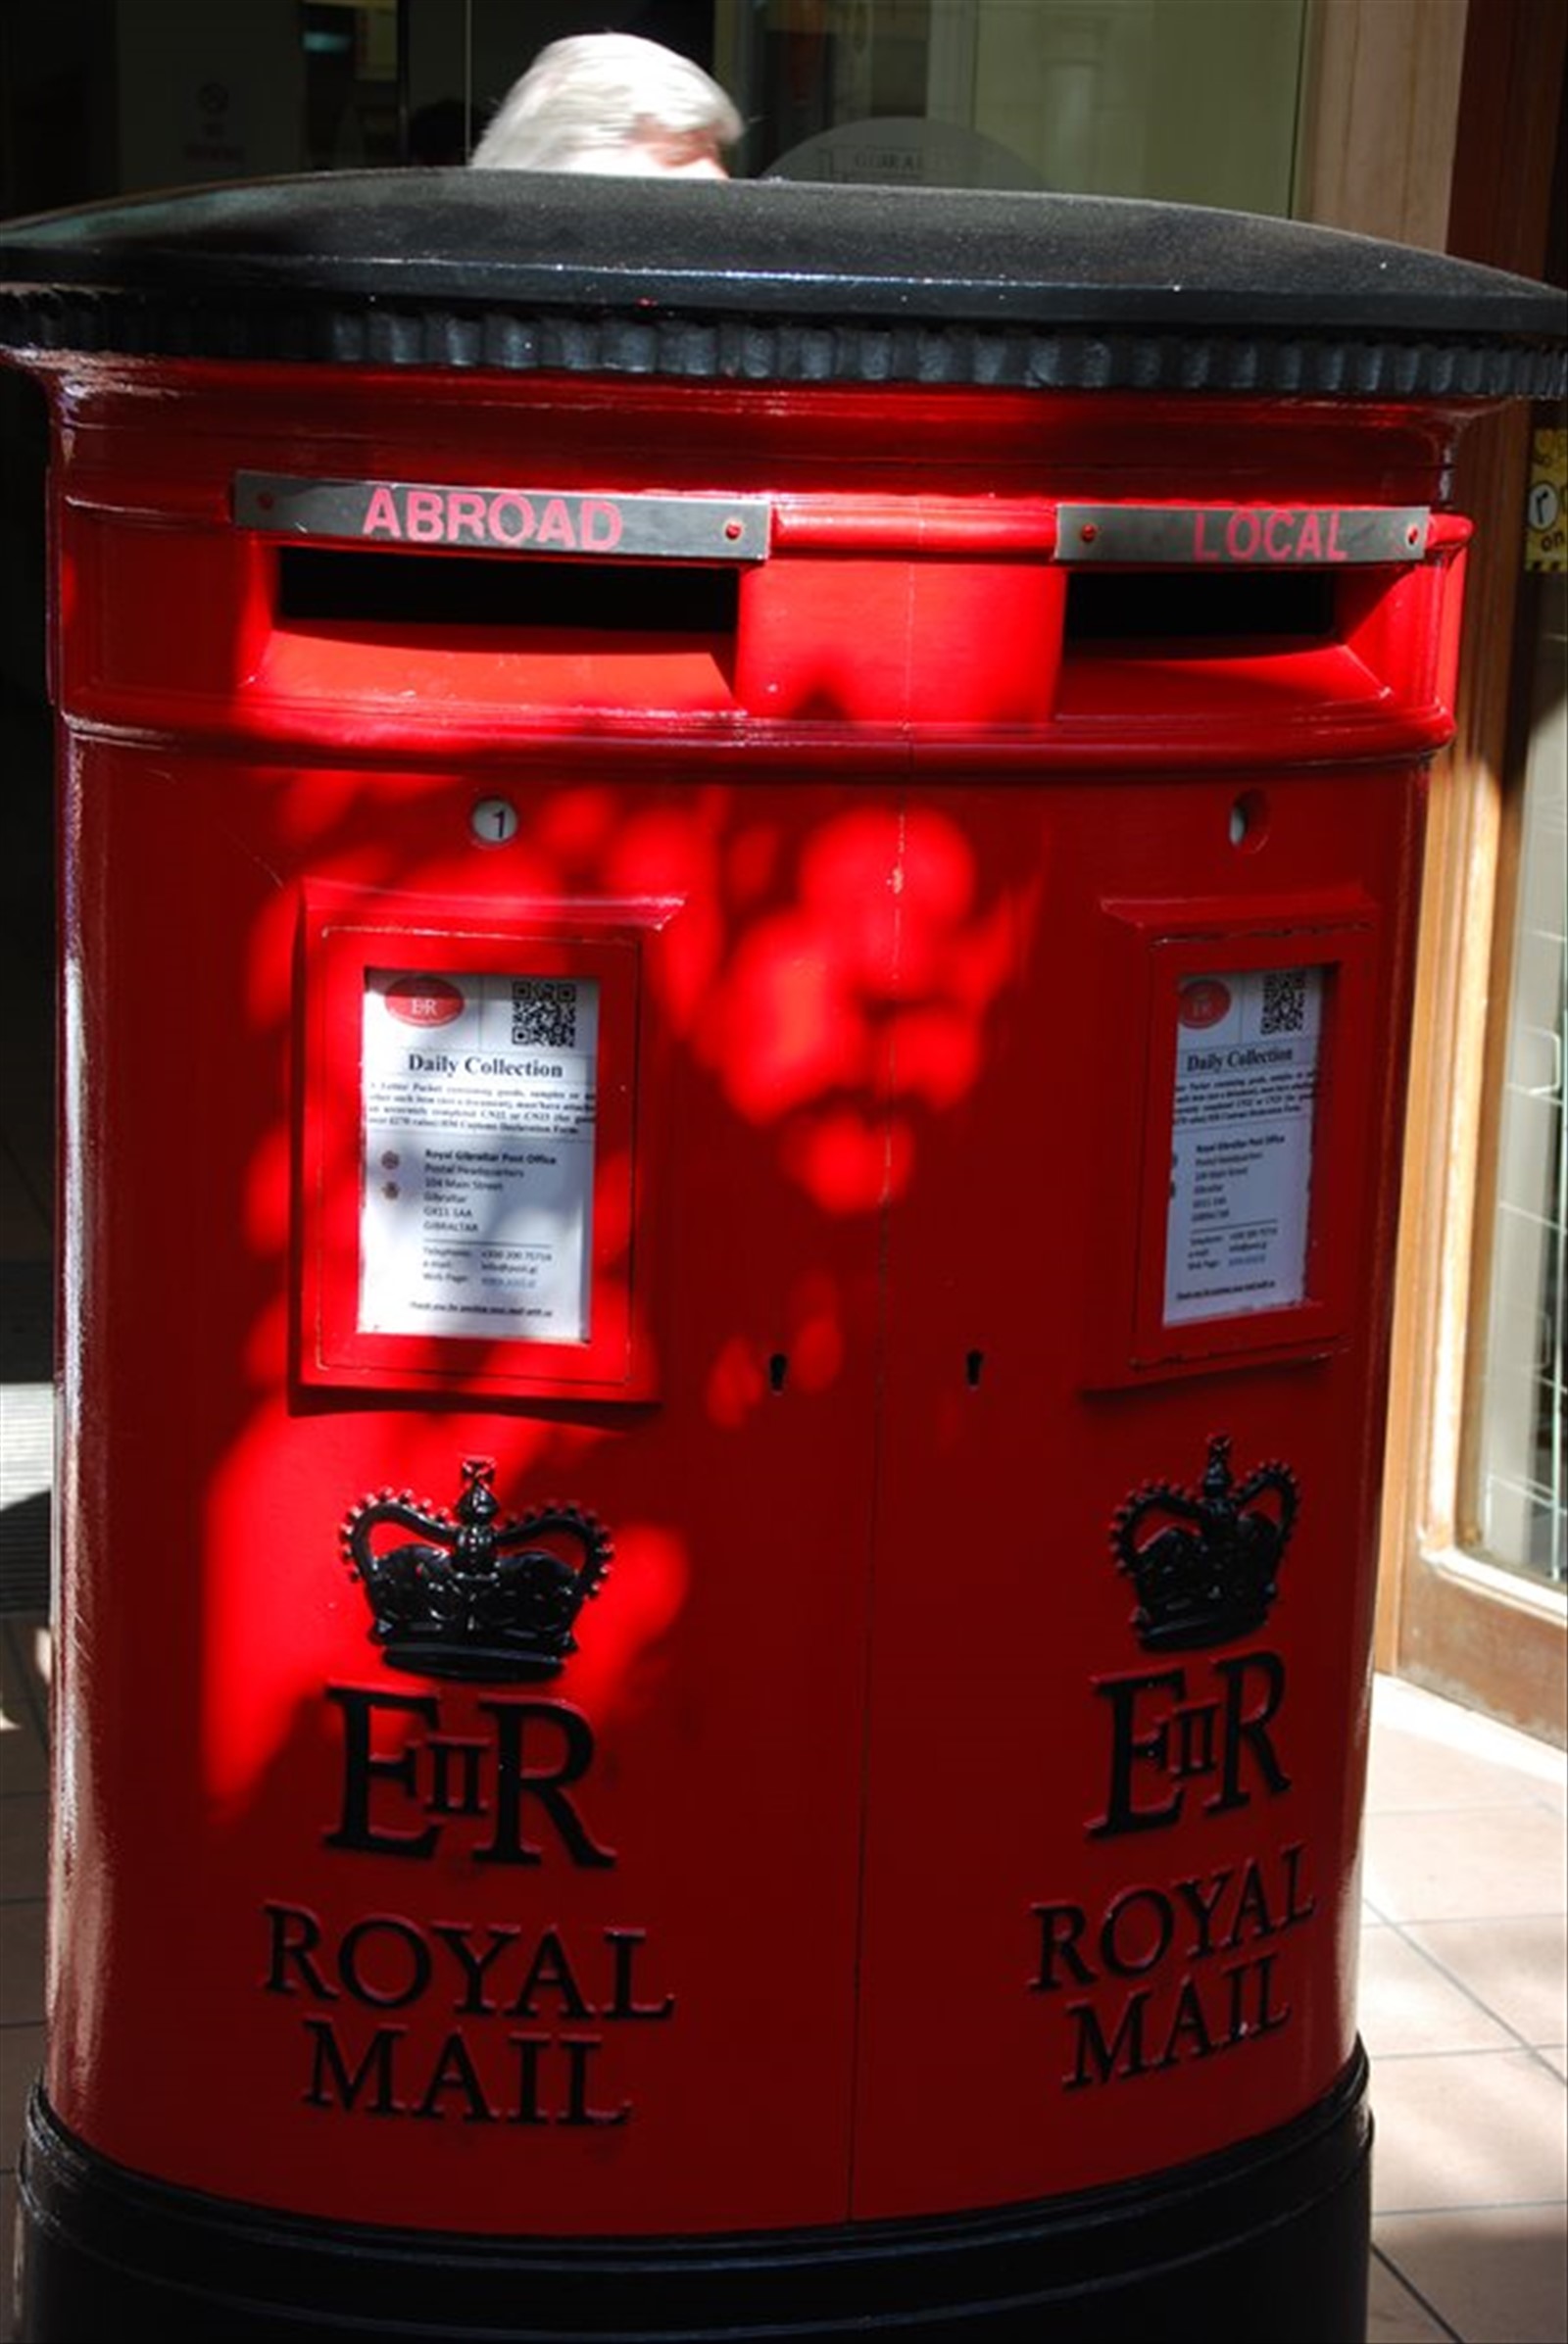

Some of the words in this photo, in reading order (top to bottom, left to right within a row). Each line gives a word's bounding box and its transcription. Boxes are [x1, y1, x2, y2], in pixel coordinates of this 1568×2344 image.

[362, 487, 623, 552] ABROAD
[1192, 509, 1348, 562] LOCAL
[493, 809, 505, 839] 1
[409, 1054, 458, 1078] Daily
[464, 1055, 564, 1078] Collection
[1187, 1052, 1224, 1073] Daily
[425, 1148, 453, 1160] Royal
[456, 1150, 499, 1161] Gibraltar
[502, 1152, 523, 1162] Post
[526, 1152, 557, 1165] Office
[1027, 1841, 1316, 1992] ROYAL
[263, 1899, 676, 2021] ROYAL
[1062, 1954, 1291, 2092] MAIL
[301, 2013, 633, 2126] MAIL
